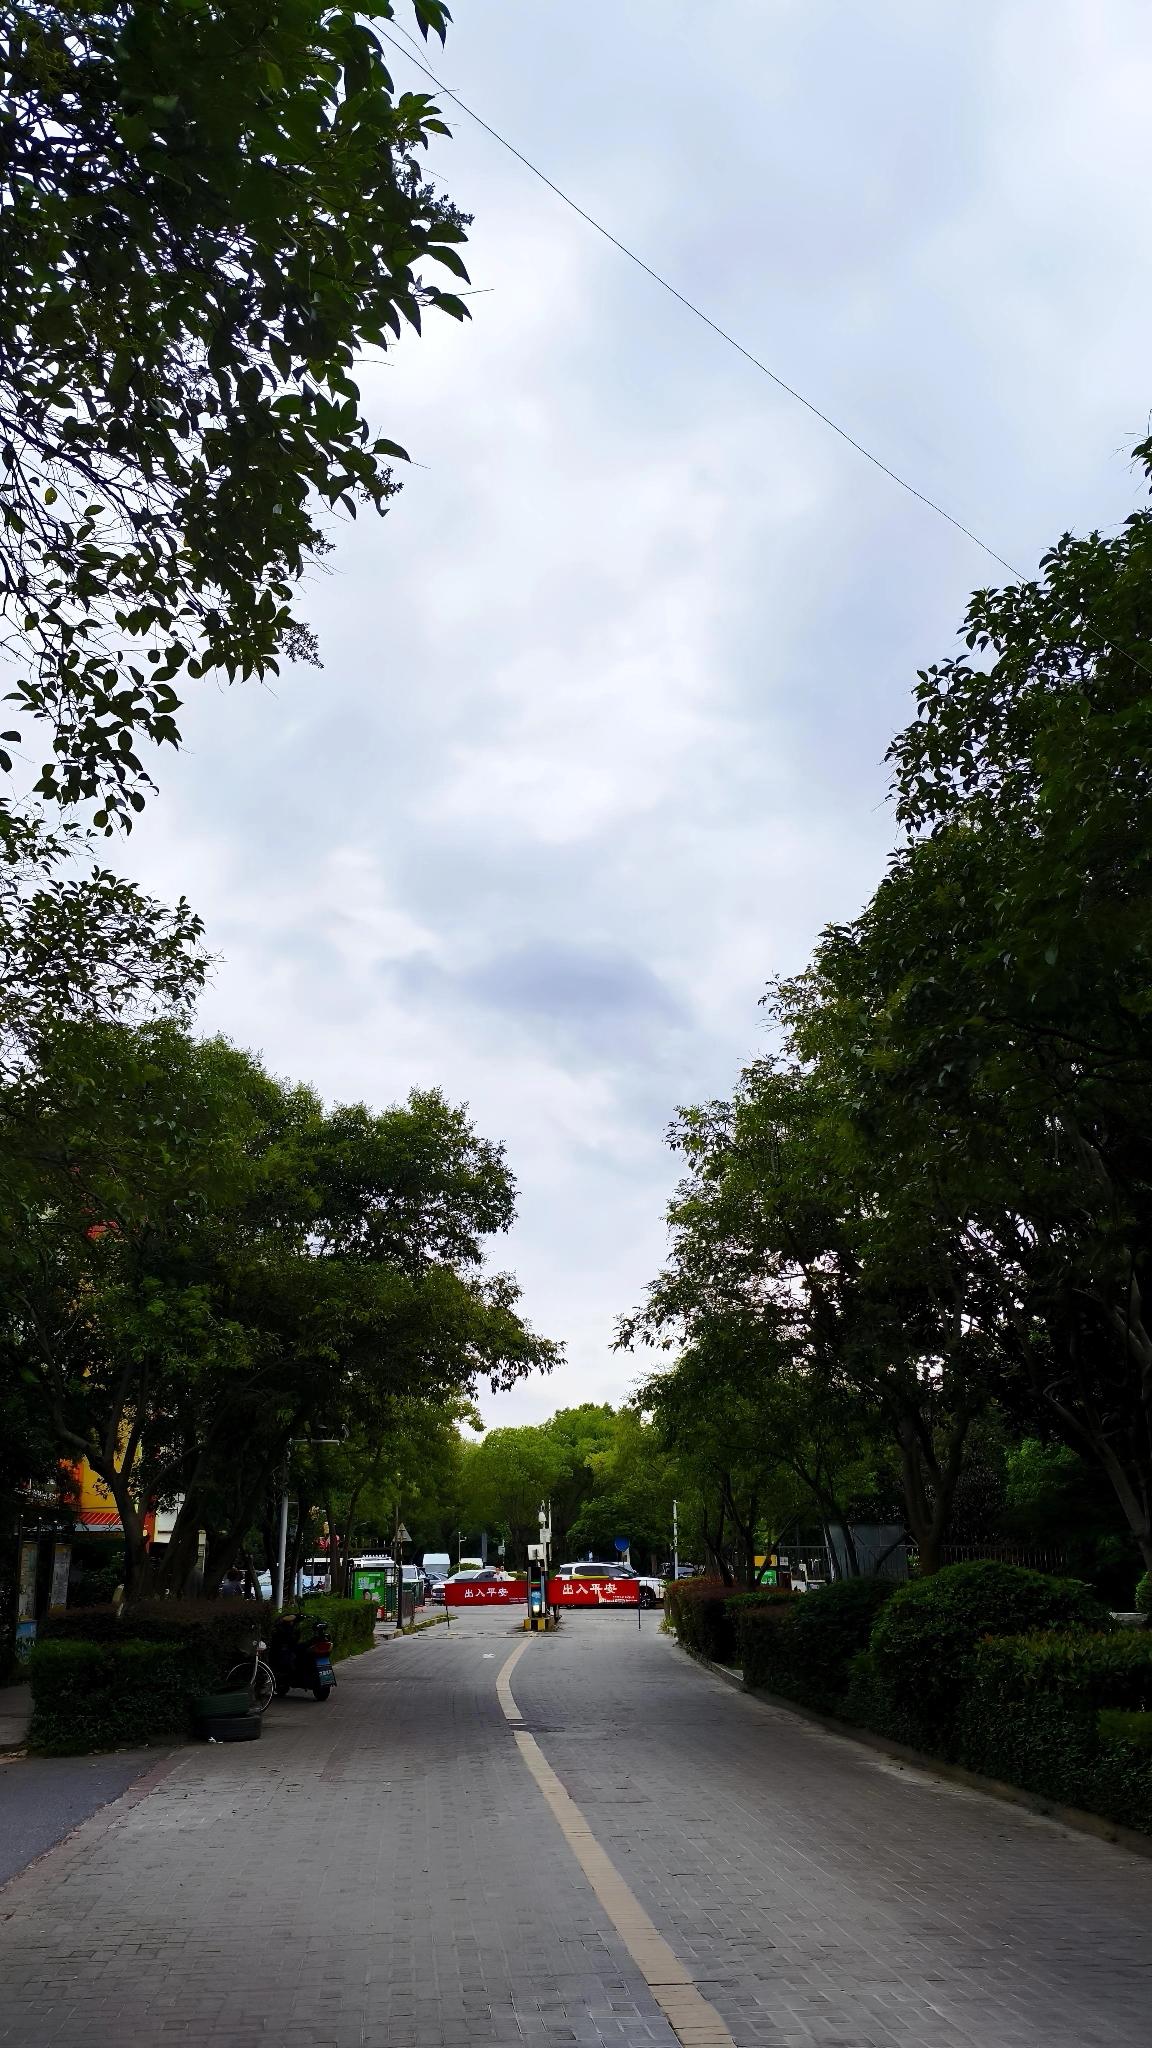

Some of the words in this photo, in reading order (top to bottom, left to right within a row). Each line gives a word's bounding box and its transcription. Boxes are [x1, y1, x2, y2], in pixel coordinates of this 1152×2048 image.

[464, 1587, 509, 1599] 出入平安
[562, 1583, 617, 1595] 出入平安
